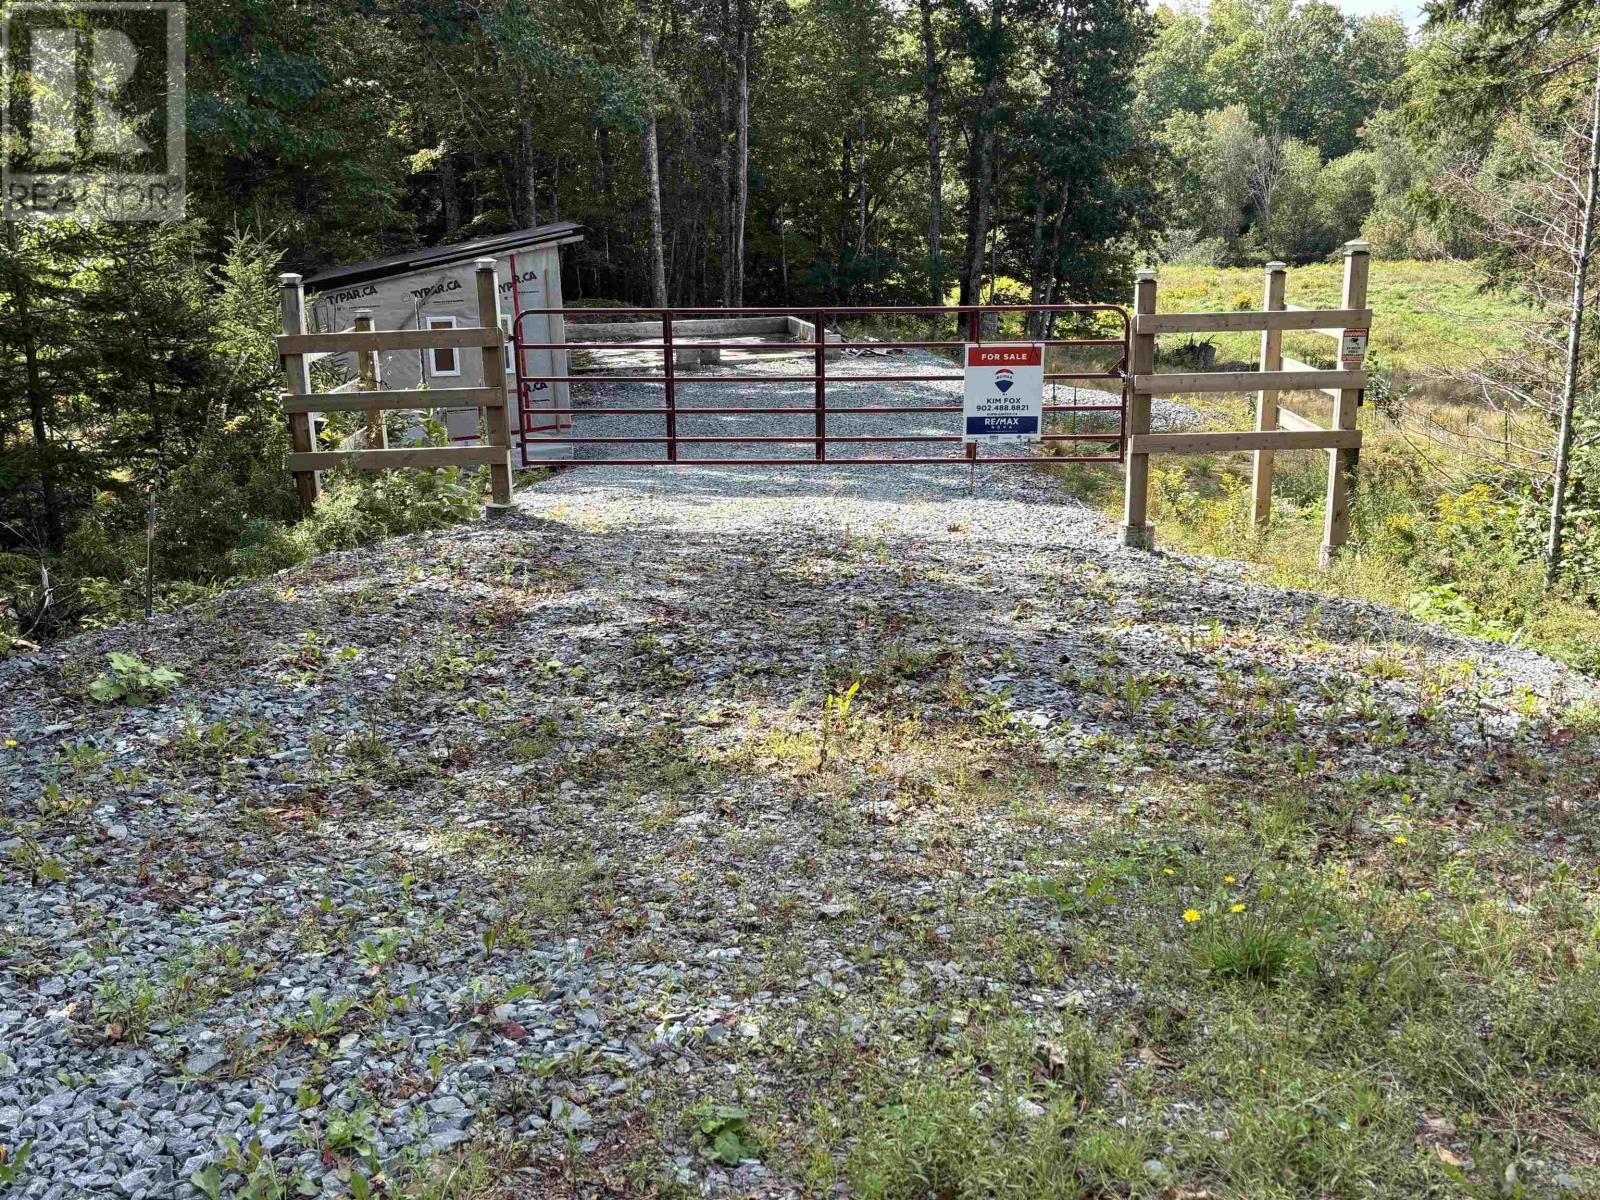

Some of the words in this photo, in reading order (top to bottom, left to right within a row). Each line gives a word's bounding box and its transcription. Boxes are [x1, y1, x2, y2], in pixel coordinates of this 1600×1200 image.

[326, 285, 378, 305] TYPAR.CA
[410, 280, 462, 300] TYPAR.CA
[976, 404, 1029, 412] 902.488.8821
[984, 417, 1019, 425] RE/MAX
